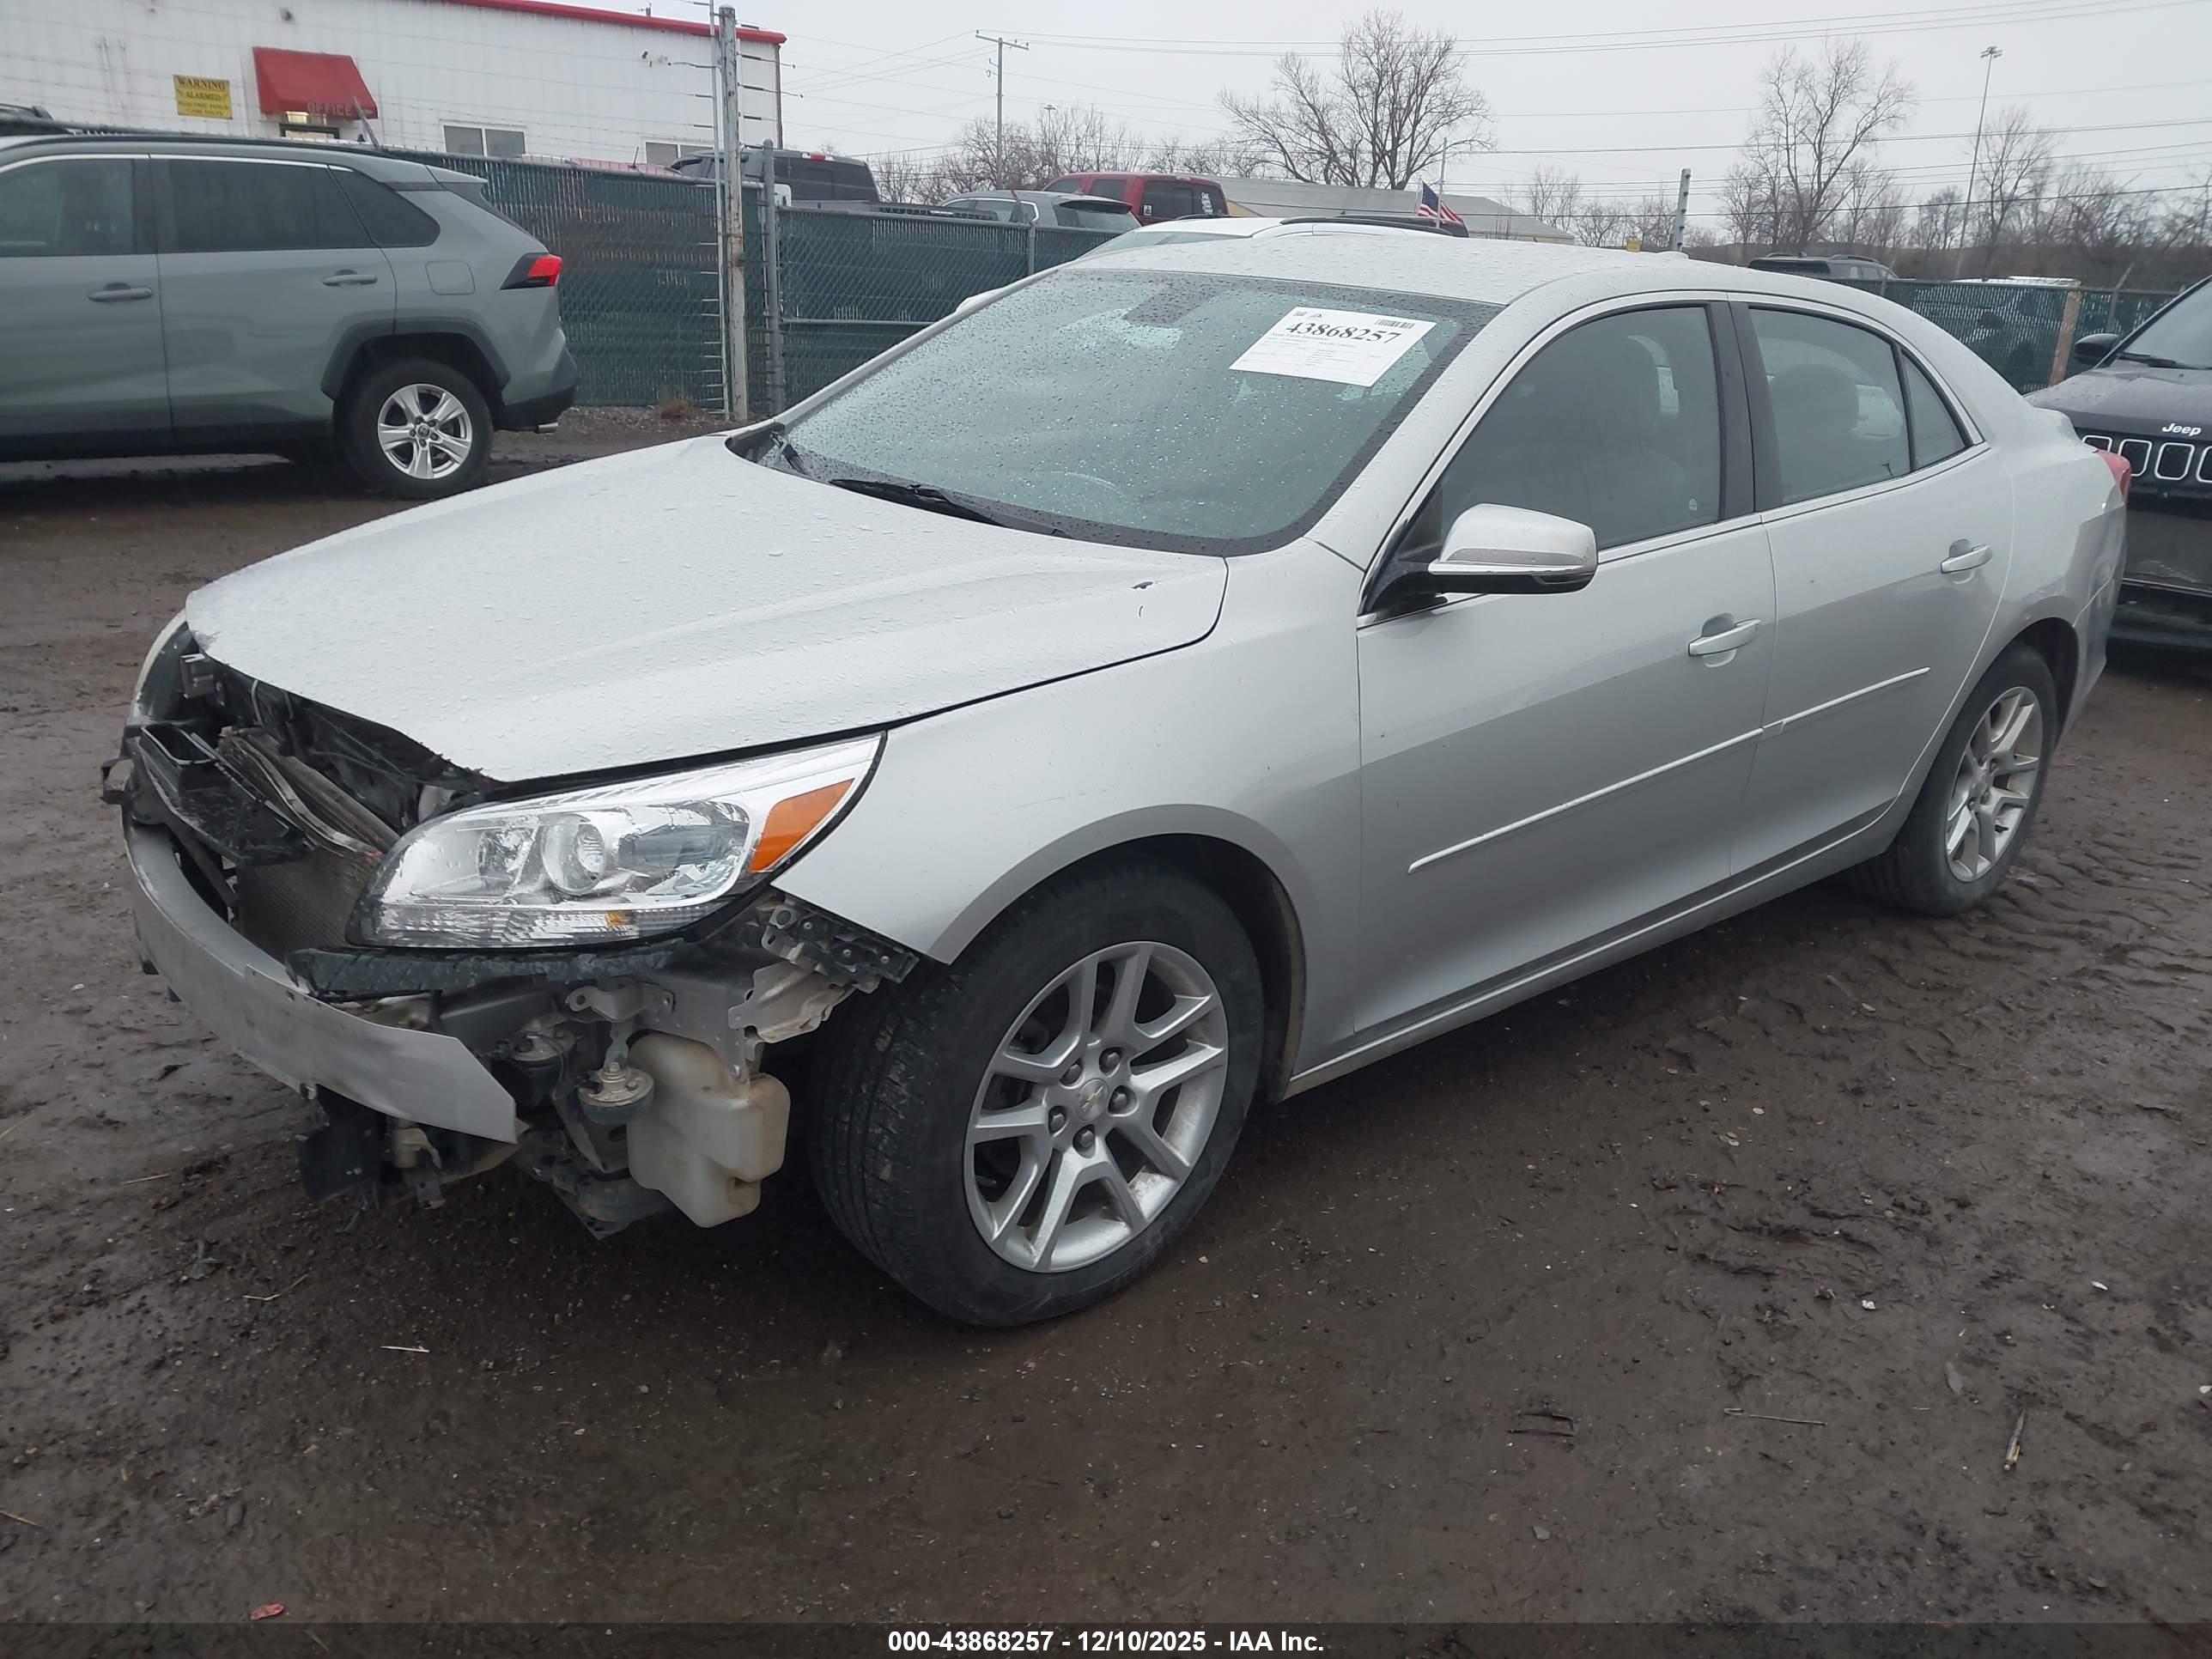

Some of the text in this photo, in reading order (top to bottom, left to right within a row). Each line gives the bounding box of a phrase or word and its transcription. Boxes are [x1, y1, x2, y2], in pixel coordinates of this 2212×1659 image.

[176, 76, 226, 90] WARNING
[307, 102, 352, 117] OFFICE
[1285, 322, 1402, 343] 43868257
[2161, 422, 2202, 436] Jeep
